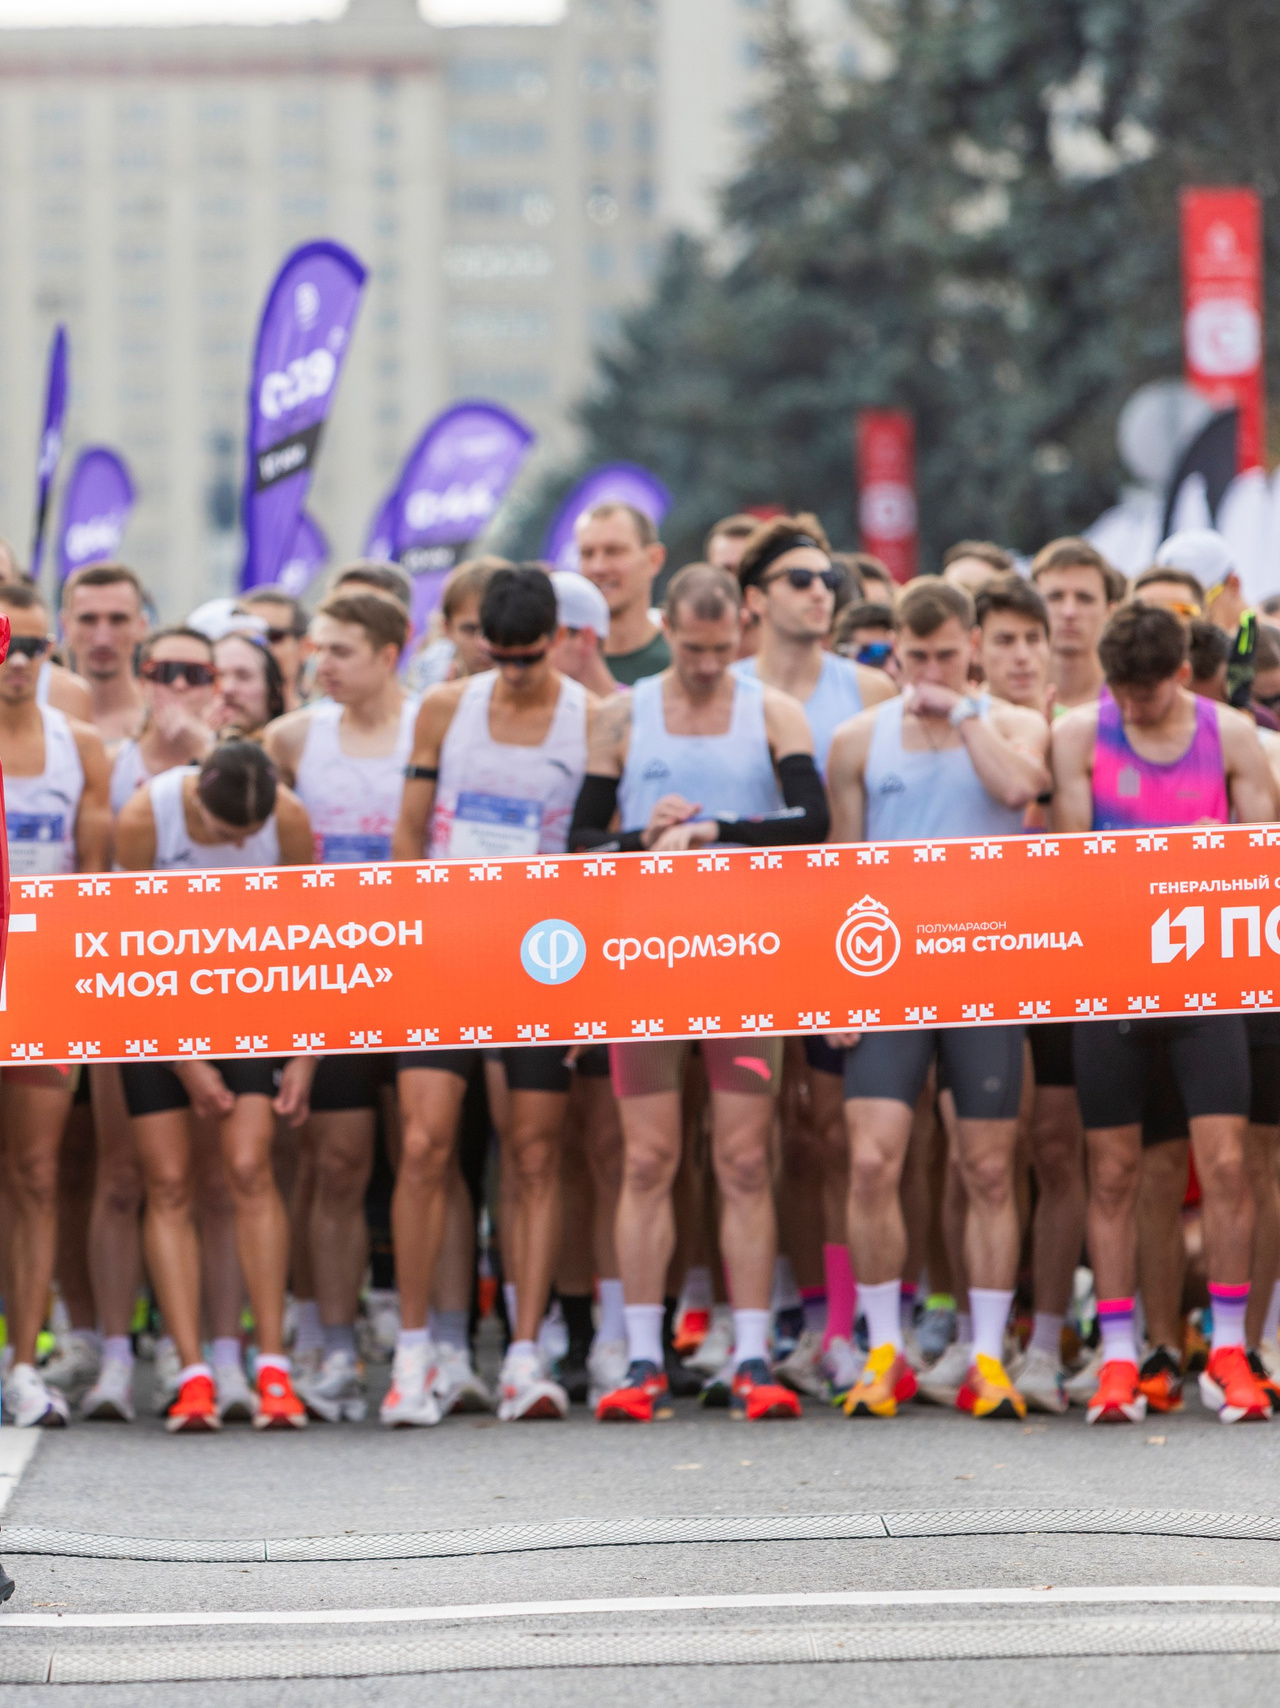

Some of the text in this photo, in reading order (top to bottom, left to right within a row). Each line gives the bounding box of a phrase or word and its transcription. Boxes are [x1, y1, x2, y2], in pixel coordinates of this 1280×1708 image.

[1149, 874, 1270, 895] ГЕНЕРАЛЬНЫЙ
[74, 920, 423, 958] IX ПОЛУМАРАФОН
[916, 921, 1007, 934] ПОЛУМАРАФОН
[916, 930, 1084, 955] МОЯ СТОЛИЦА
[1220, 905, 1280, 959] П
[603, 932, 781, 971] фармэко
[74, 963, 394, 999] «МОЯ СТОЛИЦА»
